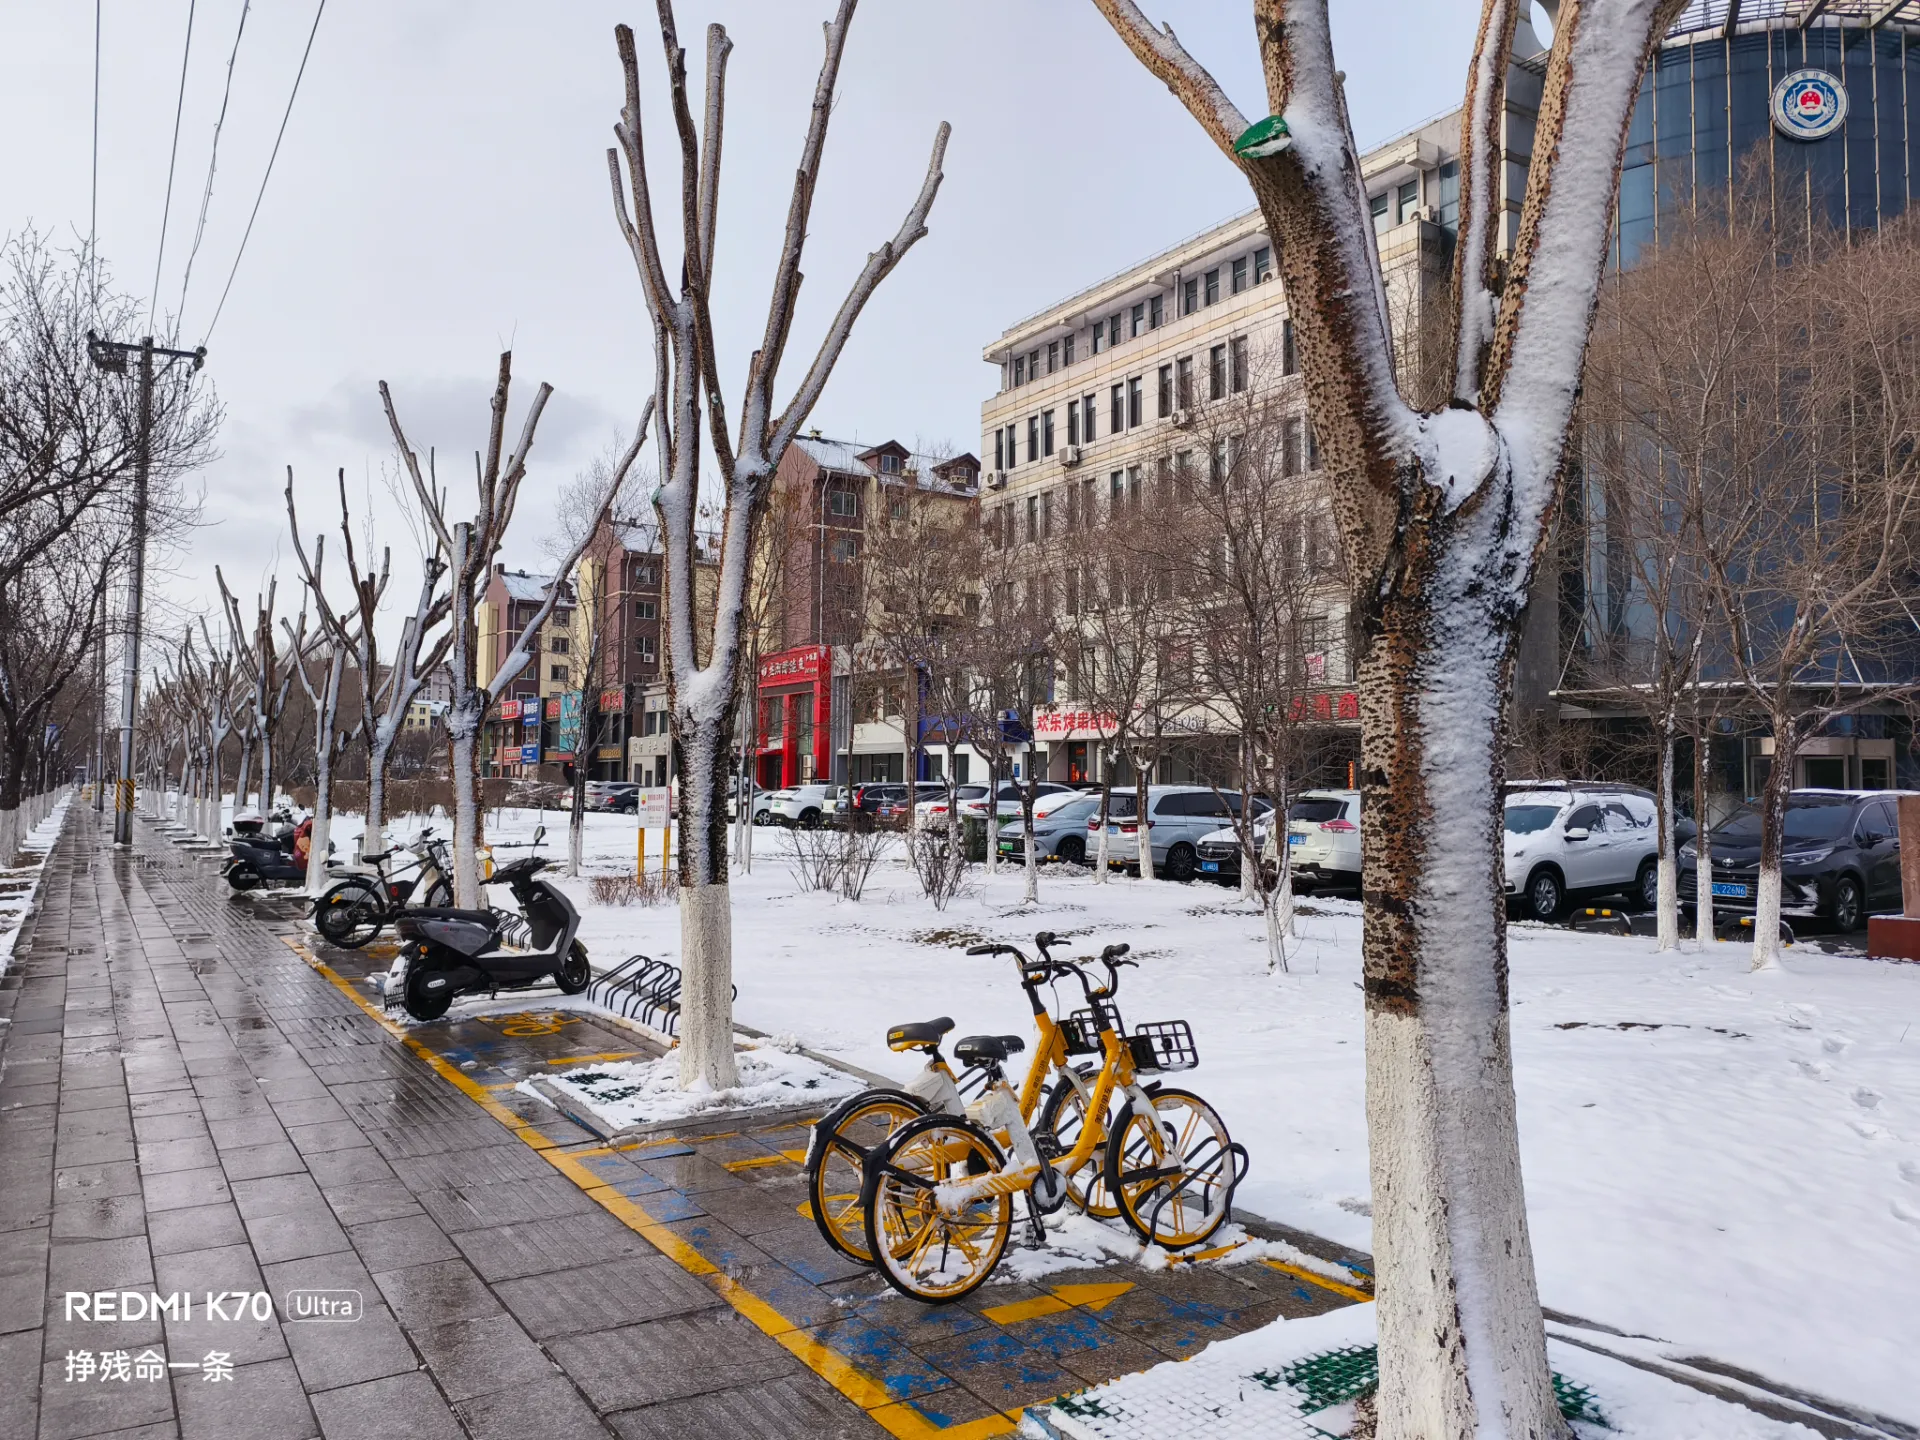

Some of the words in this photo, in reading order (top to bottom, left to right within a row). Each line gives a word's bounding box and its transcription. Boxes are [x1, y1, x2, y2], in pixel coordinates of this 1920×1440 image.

[1036, 711, 1118, 732] 欢乐烤串自助
